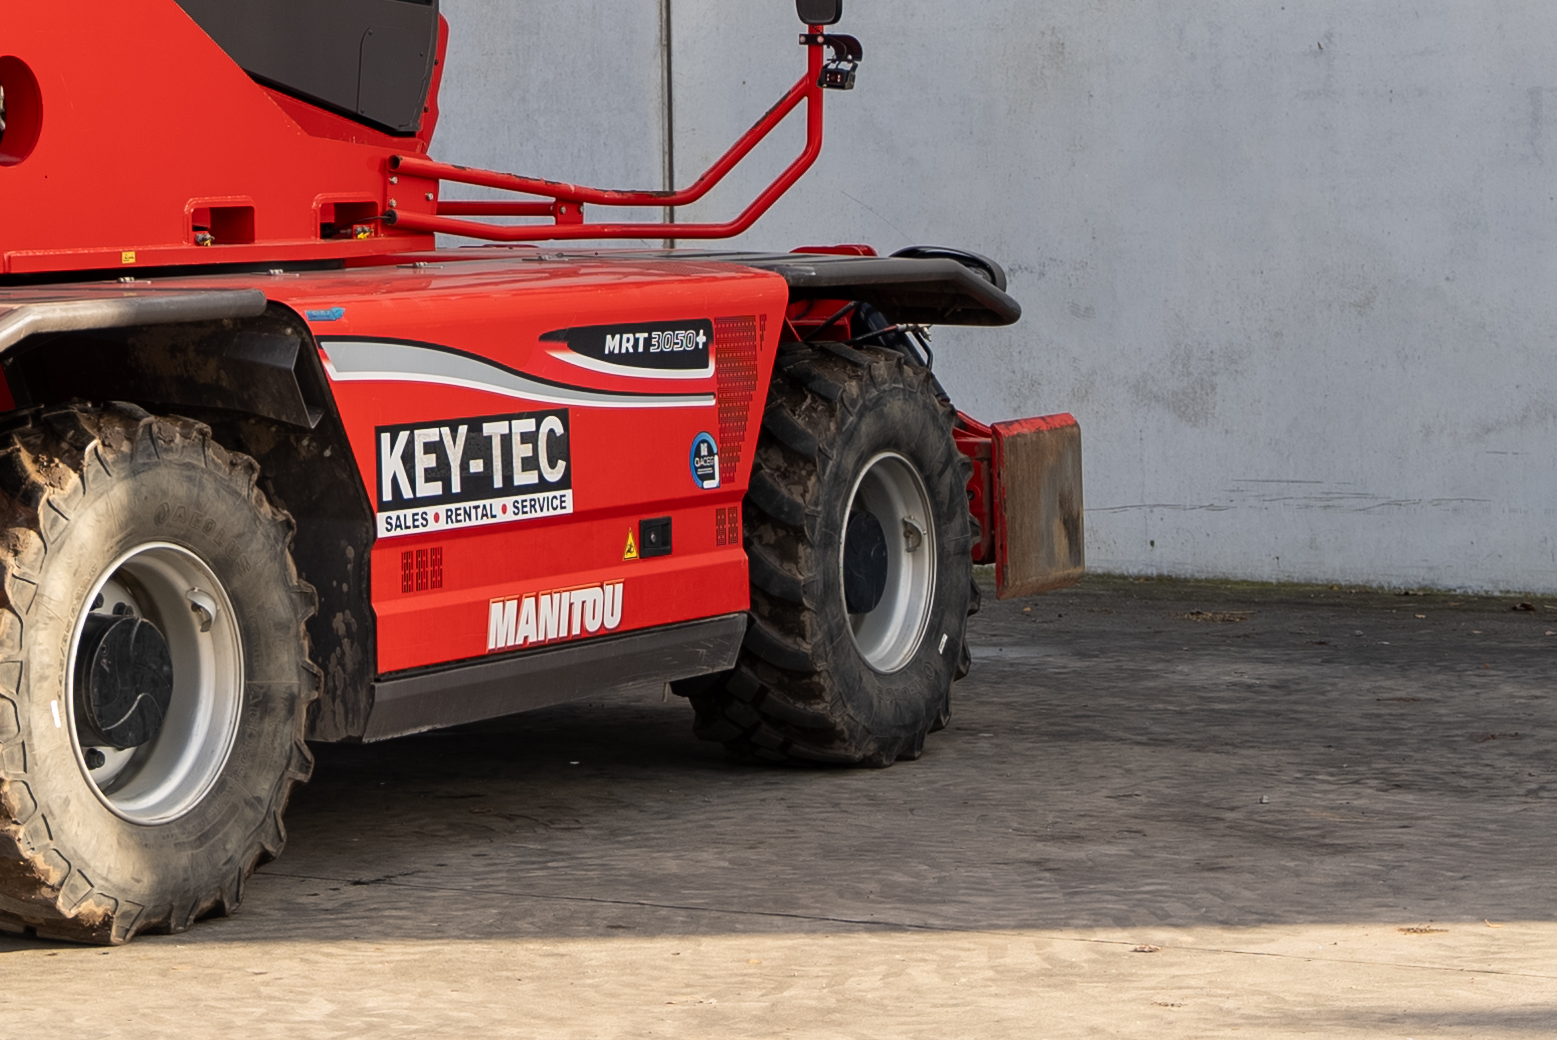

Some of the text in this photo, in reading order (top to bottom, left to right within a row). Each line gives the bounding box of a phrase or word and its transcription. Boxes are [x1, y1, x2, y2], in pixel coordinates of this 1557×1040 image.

[604, 329, 706, 354] MRT 3050+
[381, 415, 567, 502] KEY-TEC
[171, 505, 252, 577] AEOLUS
[385, 494, 567, 533] SALES RENTAL SERVICE
[487, 582, 624, 650] MANITOU
